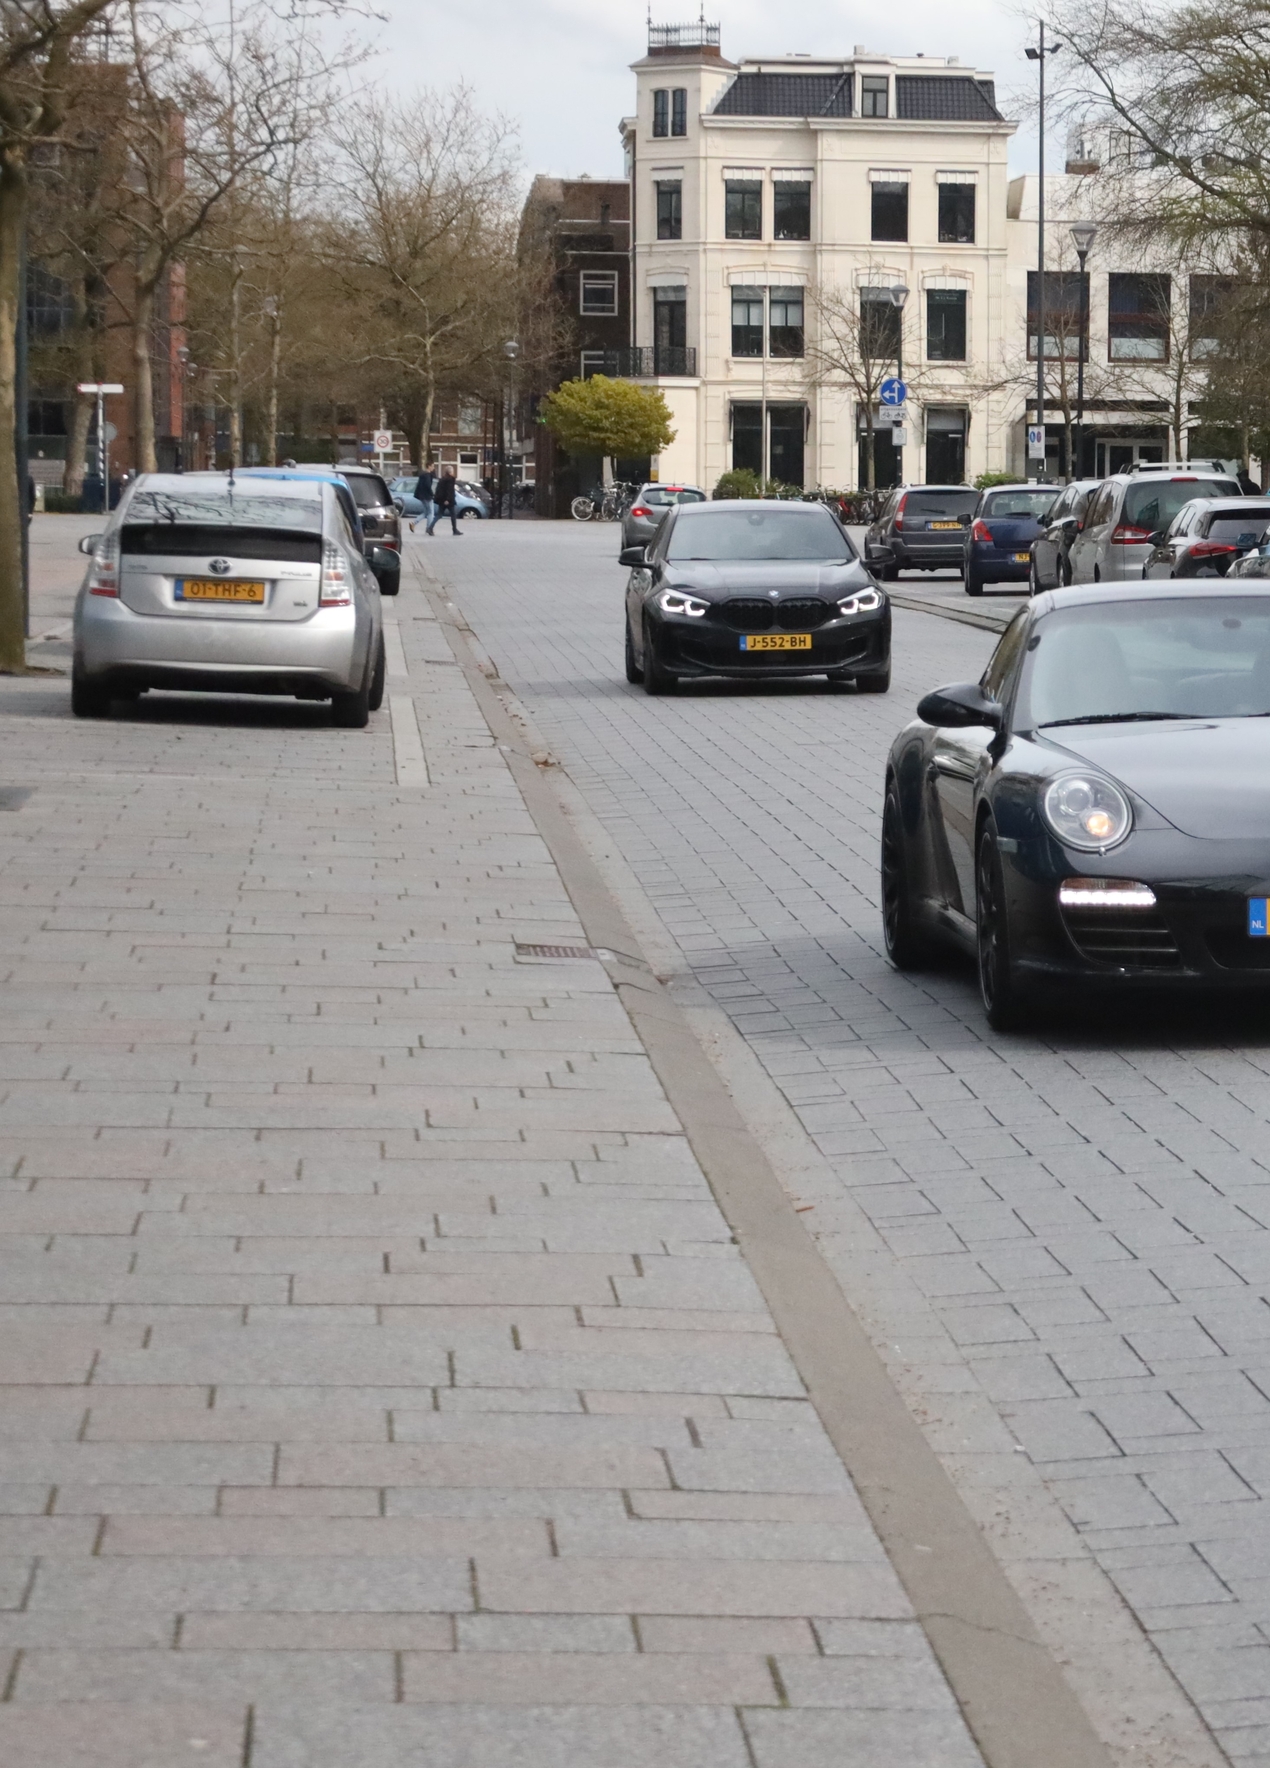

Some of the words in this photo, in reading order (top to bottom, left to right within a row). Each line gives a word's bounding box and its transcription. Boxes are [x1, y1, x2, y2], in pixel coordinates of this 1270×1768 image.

[190, 582, 257, 598] 01-THF-6
[750, 636, 807, 648] J-552-BH
[1252, 920, 1264, 929] NL
